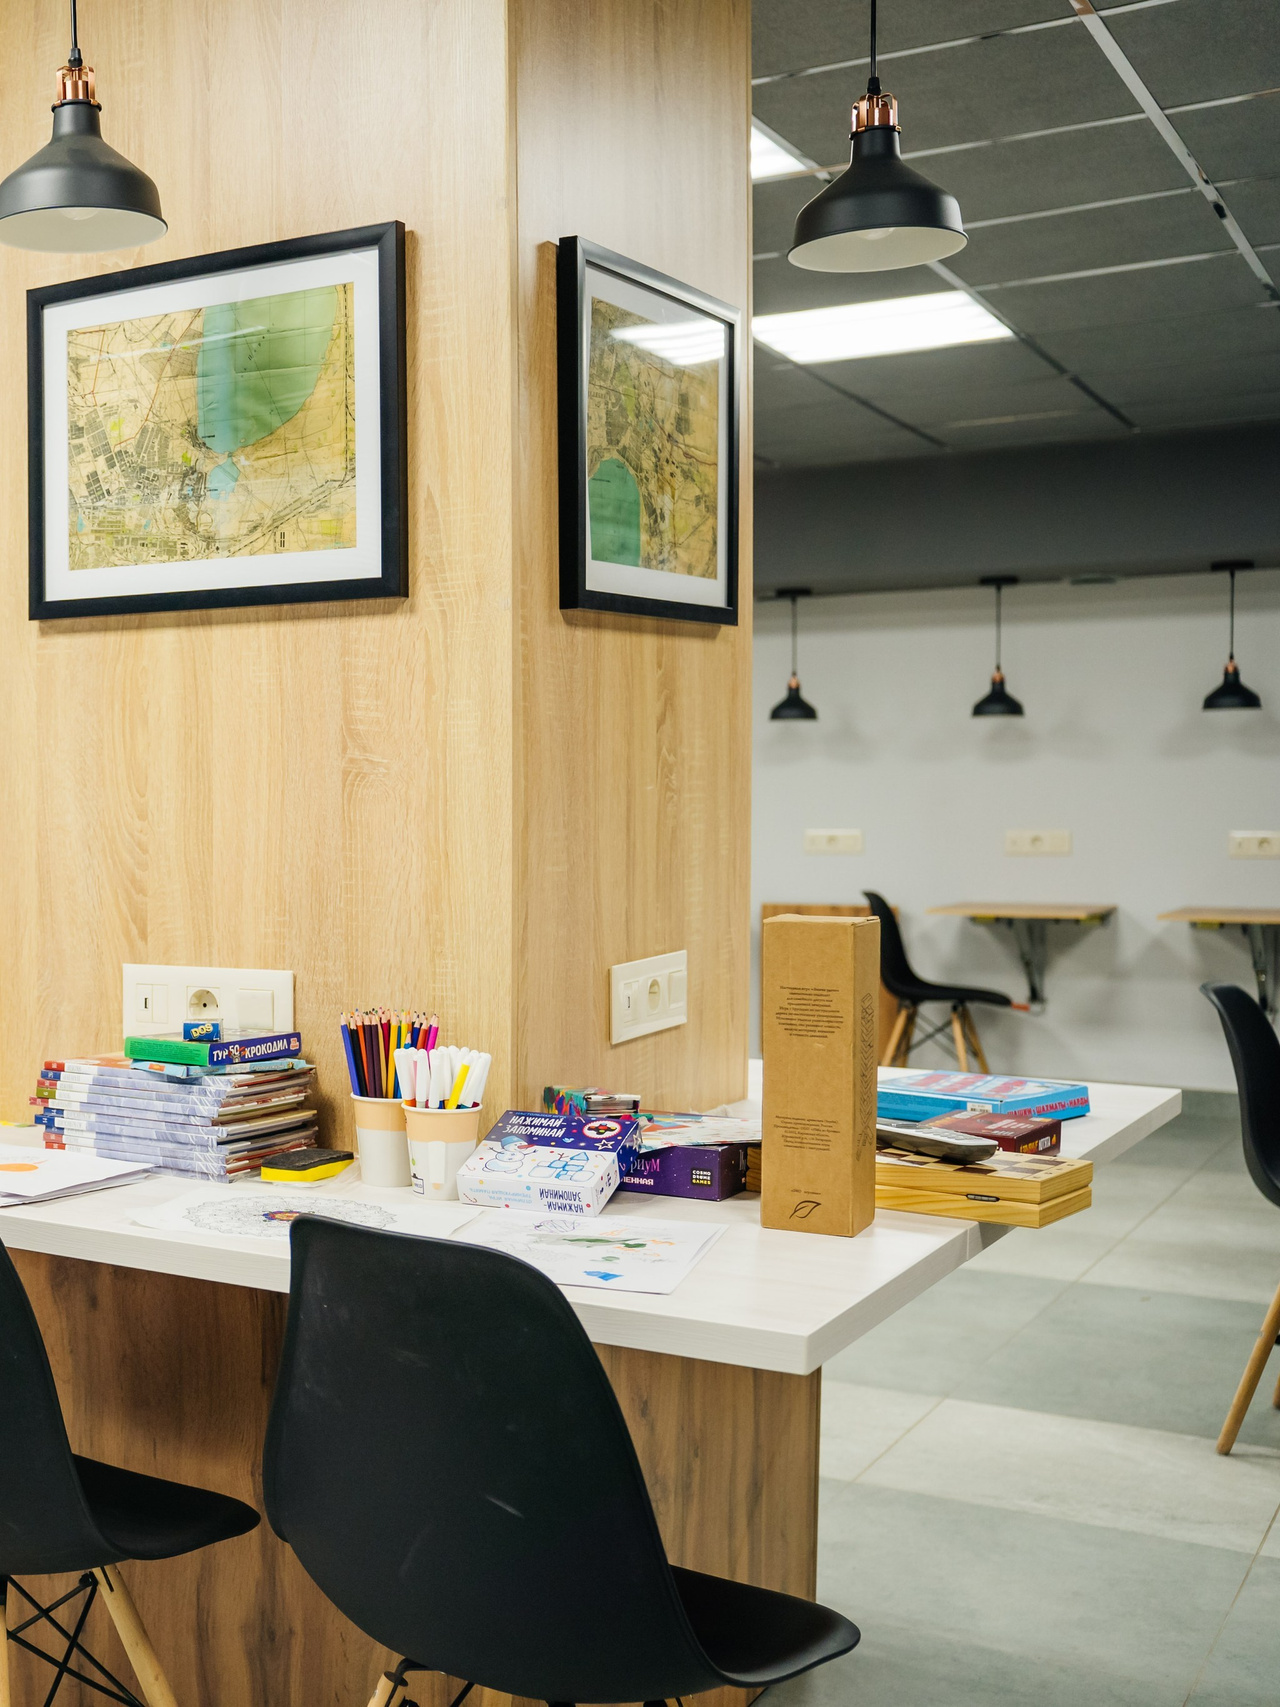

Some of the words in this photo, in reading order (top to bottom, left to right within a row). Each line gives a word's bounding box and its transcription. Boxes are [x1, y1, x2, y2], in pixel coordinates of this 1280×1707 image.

[190, 1023, 214, 1039] DOS
[245, 1039, 288, 1058] КРОКОДИЛ
[1035, 1100, 1066, 1114] ШАХМАТЫ
[509, 1116, 567, 1128] НАЖИМАЙ-
[502, 1125, 566, 1138] ЗАПОМИНАЙ
[539, 1188, 582, 1202] ЗАПОМИНАЙ
[543, 1201, 584, 1213] НАЖИМАЙ-
